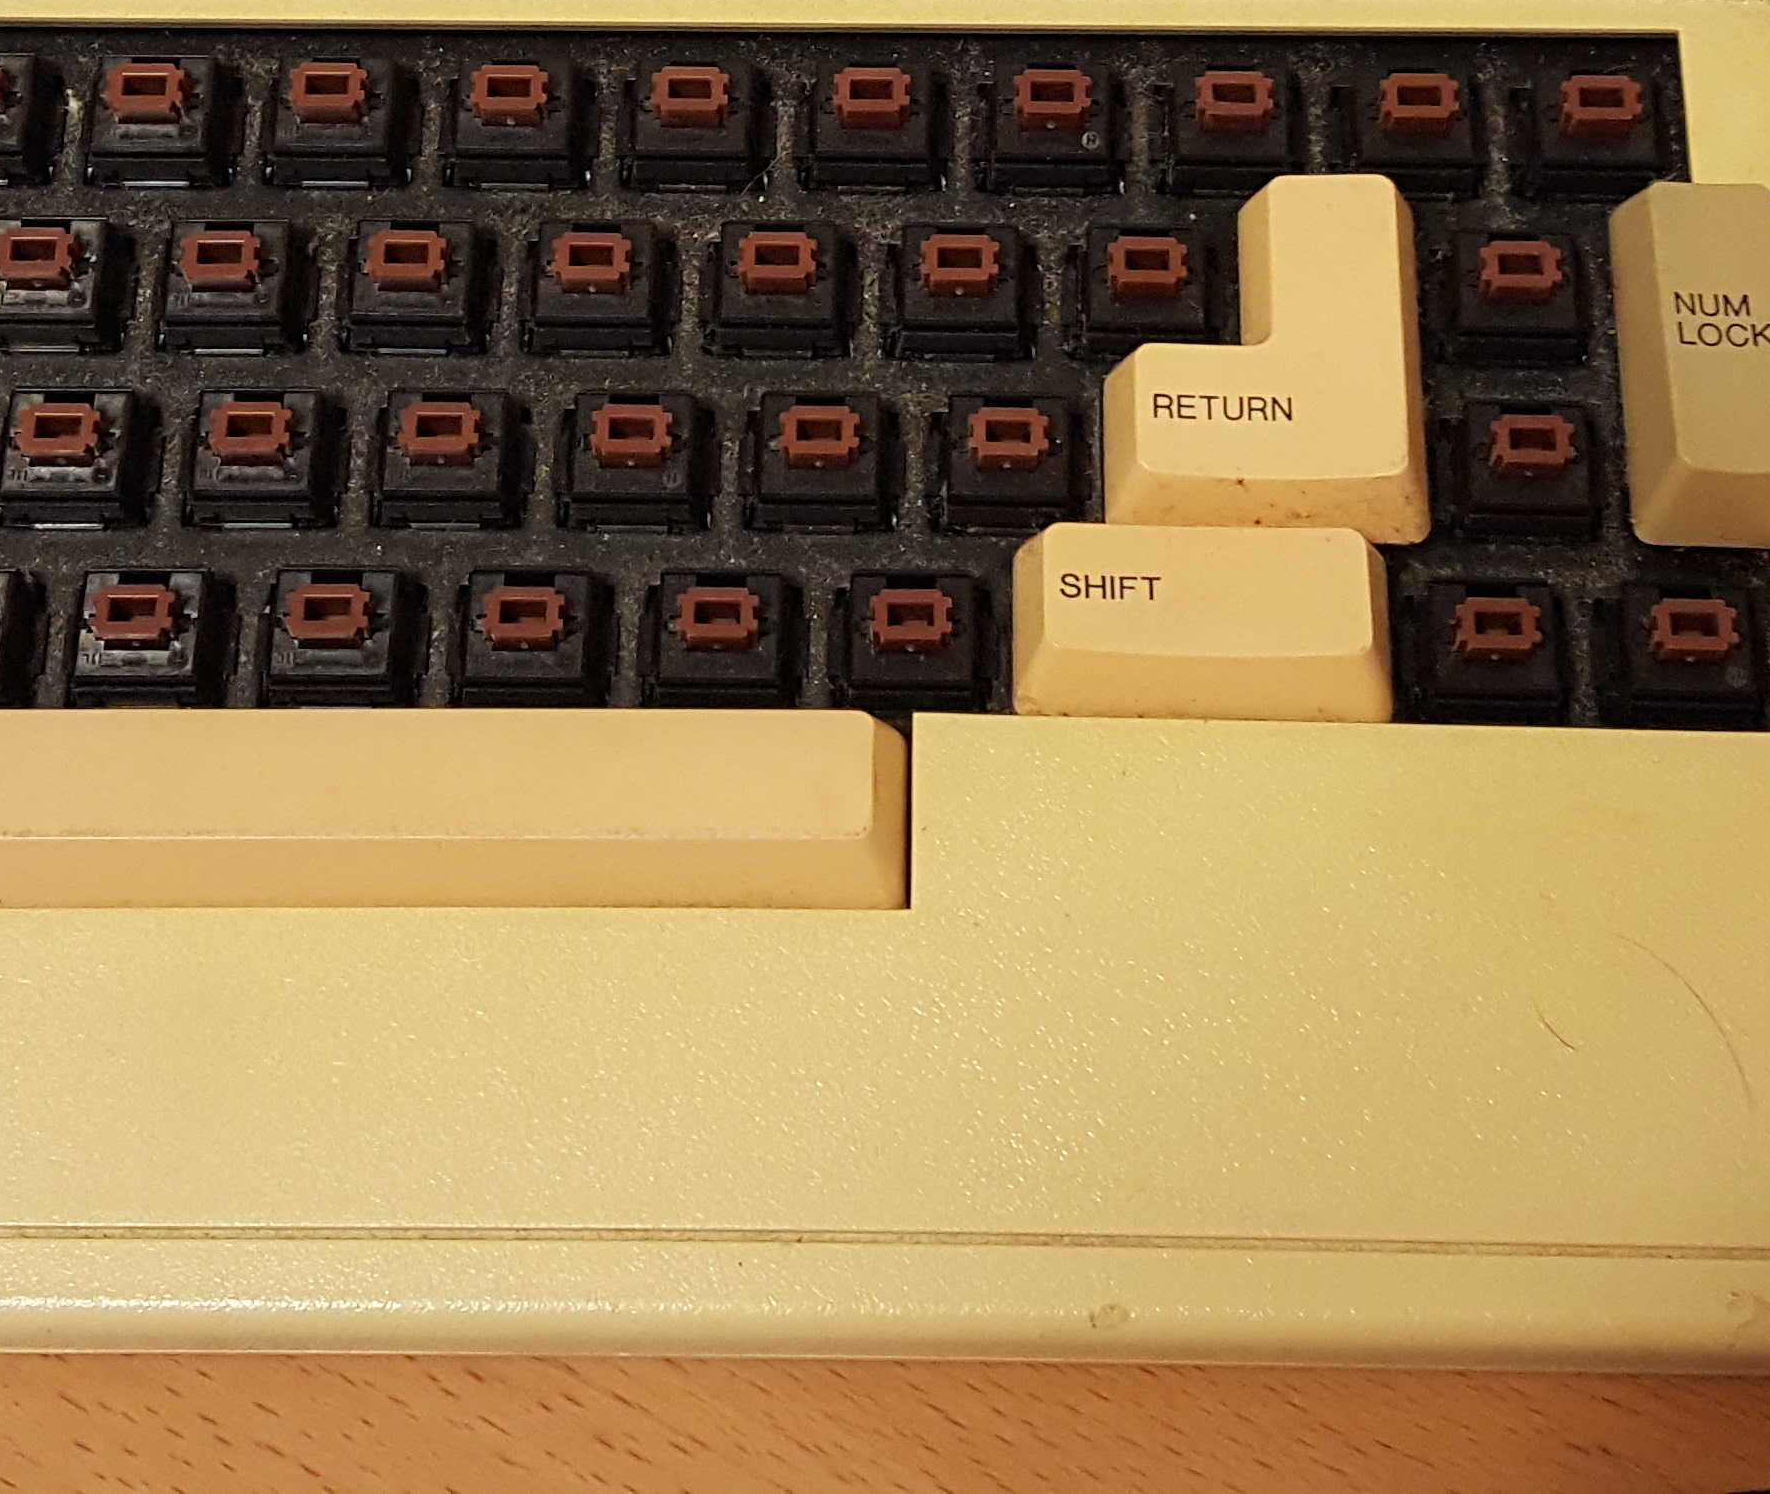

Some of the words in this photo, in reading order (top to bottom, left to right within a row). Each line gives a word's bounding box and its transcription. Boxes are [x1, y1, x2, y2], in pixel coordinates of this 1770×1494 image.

[1675, 291, 1751, 317] NUM
[1153, 392, 1293, 422] RETURN
[1060, 572, 1161, 600] SHIFT
